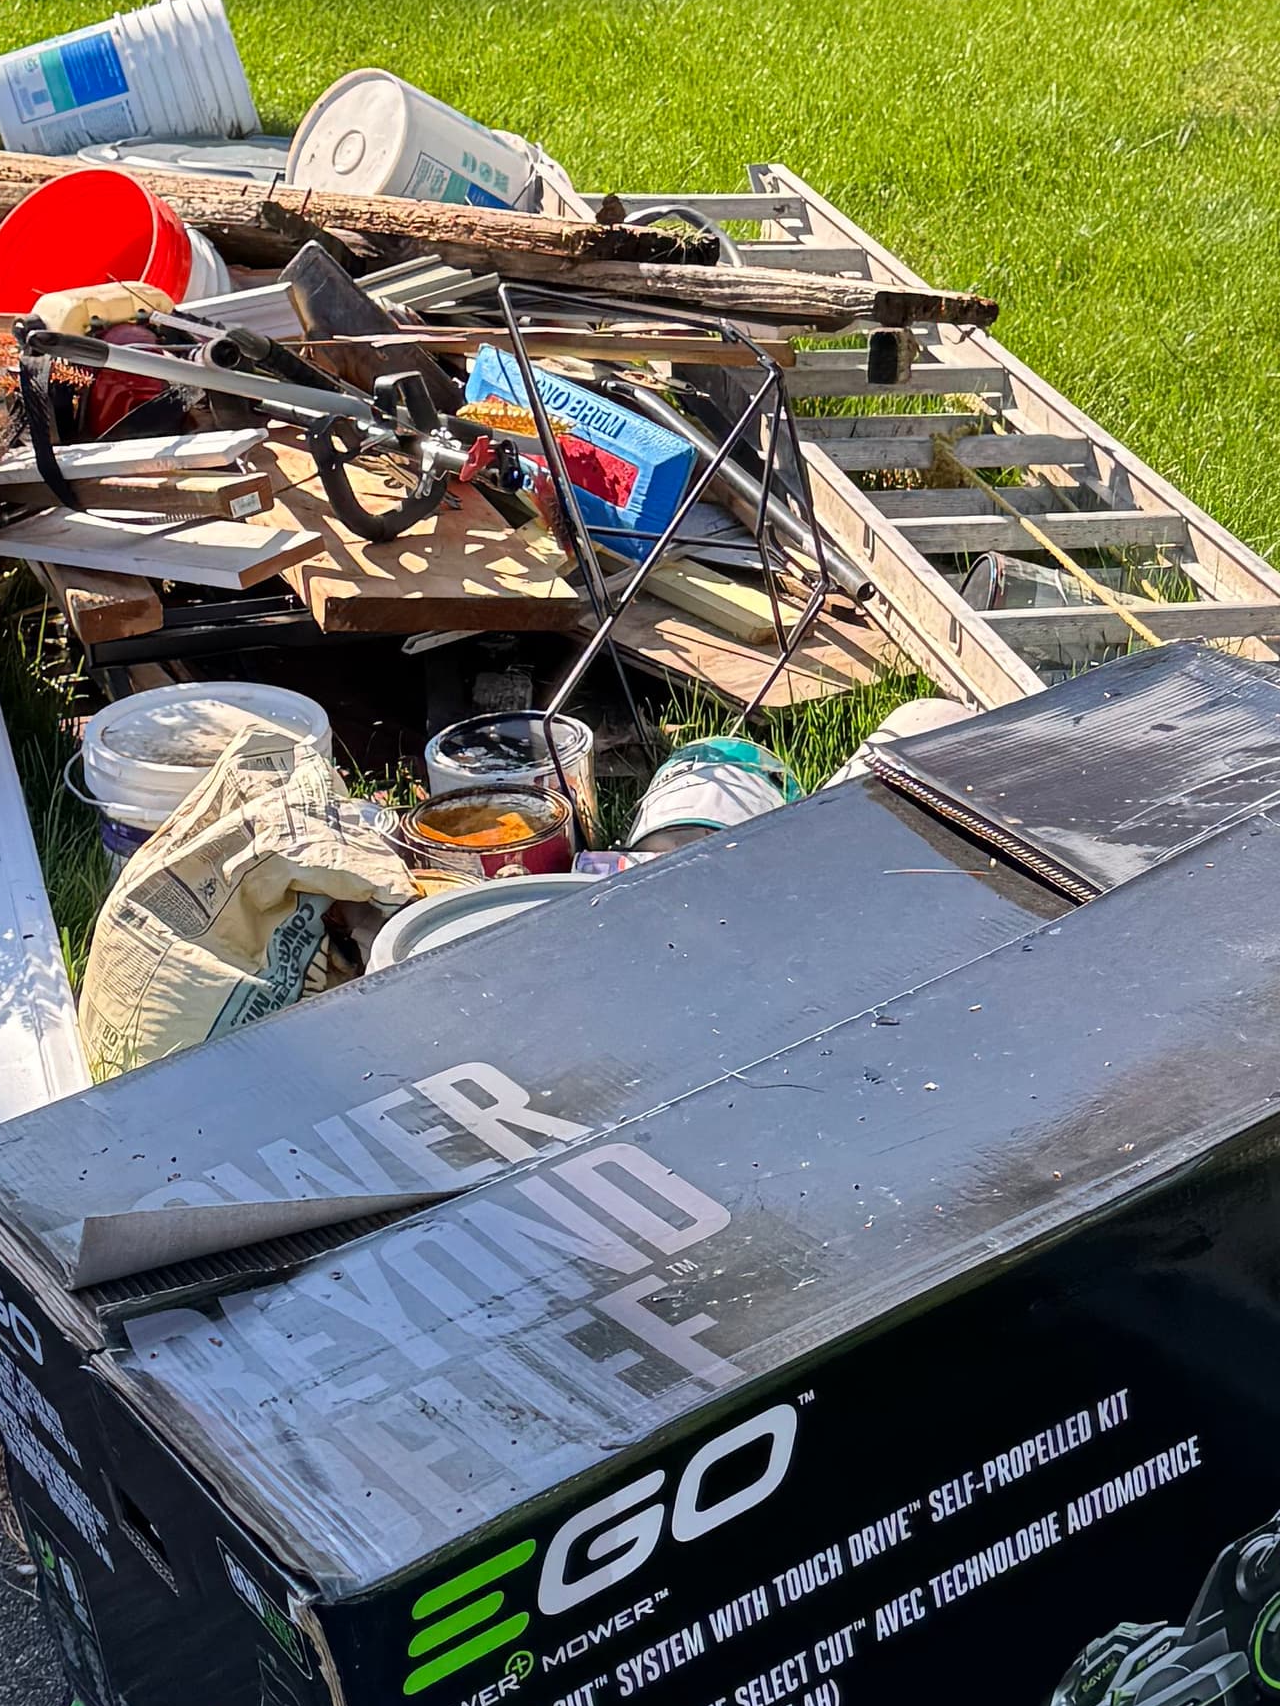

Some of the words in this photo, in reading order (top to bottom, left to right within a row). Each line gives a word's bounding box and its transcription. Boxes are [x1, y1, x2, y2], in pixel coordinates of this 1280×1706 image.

[616, 1622, 704, 1696] SYSTEM
[709, 1586, 769, 1642] WITH
[773, 1544, 843, 1607] TOUCH
[929, 1411, 1091, 1522] SELF-PROPELLED
[1098, 1389, 1127, 1431] KIT
[876, 1588, 925, 1641] AVEC
[929, 1512, 1061, 1608] TECHNOLOGIE
[1068, 1435, 1201, 1534] AUTOMOTRICE
